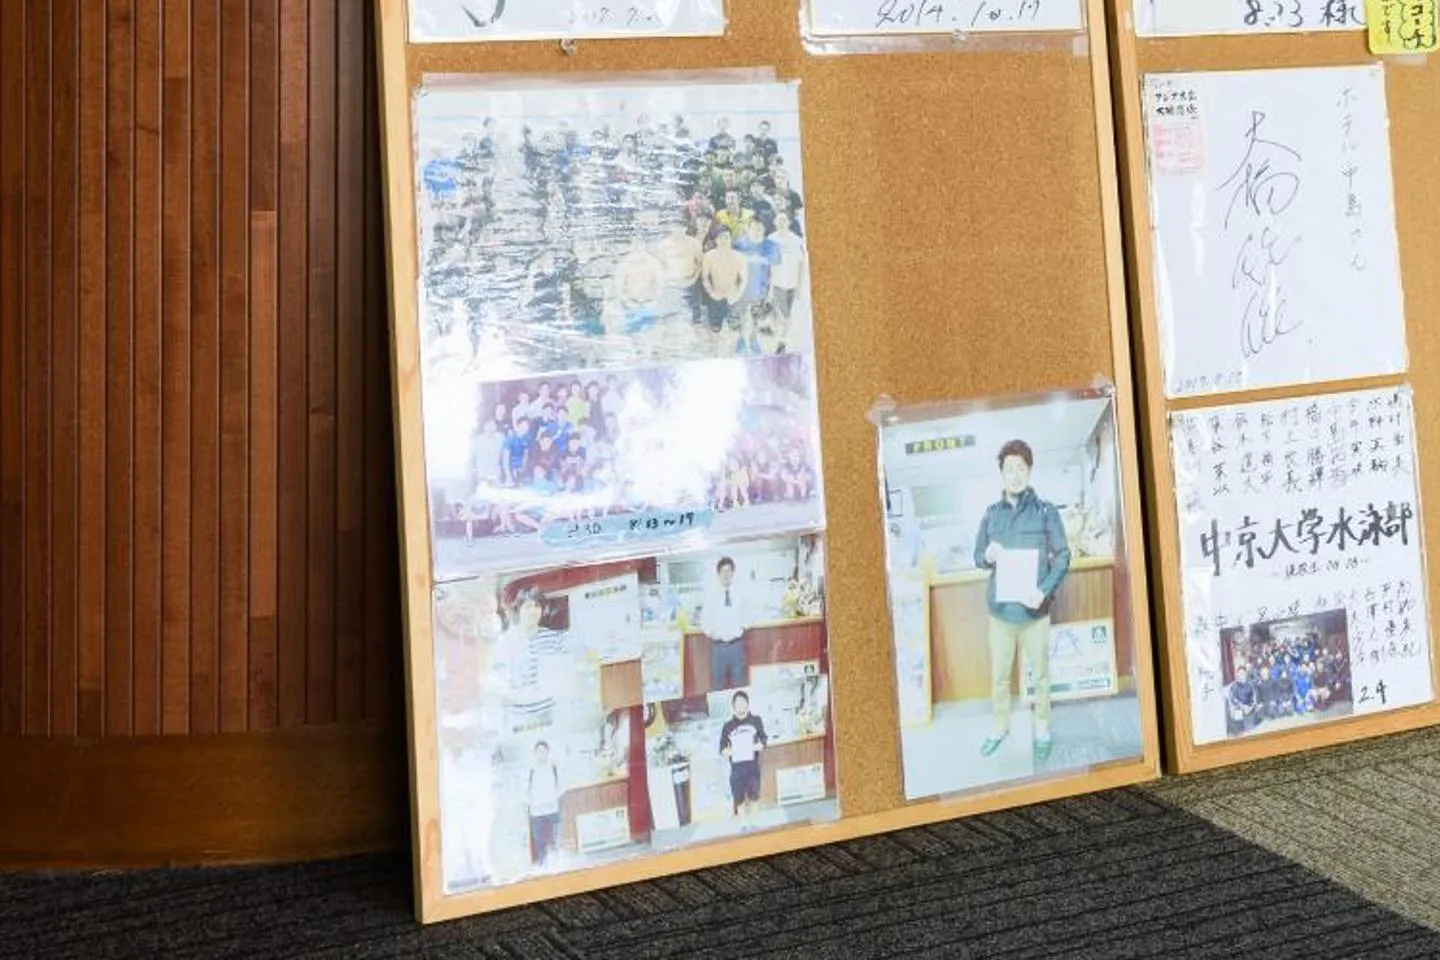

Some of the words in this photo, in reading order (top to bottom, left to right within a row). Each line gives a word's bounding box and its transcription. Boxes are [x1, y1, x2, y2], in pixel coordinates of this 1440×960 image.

[1199, 500, 1414, 577] 中京大学水泳部
